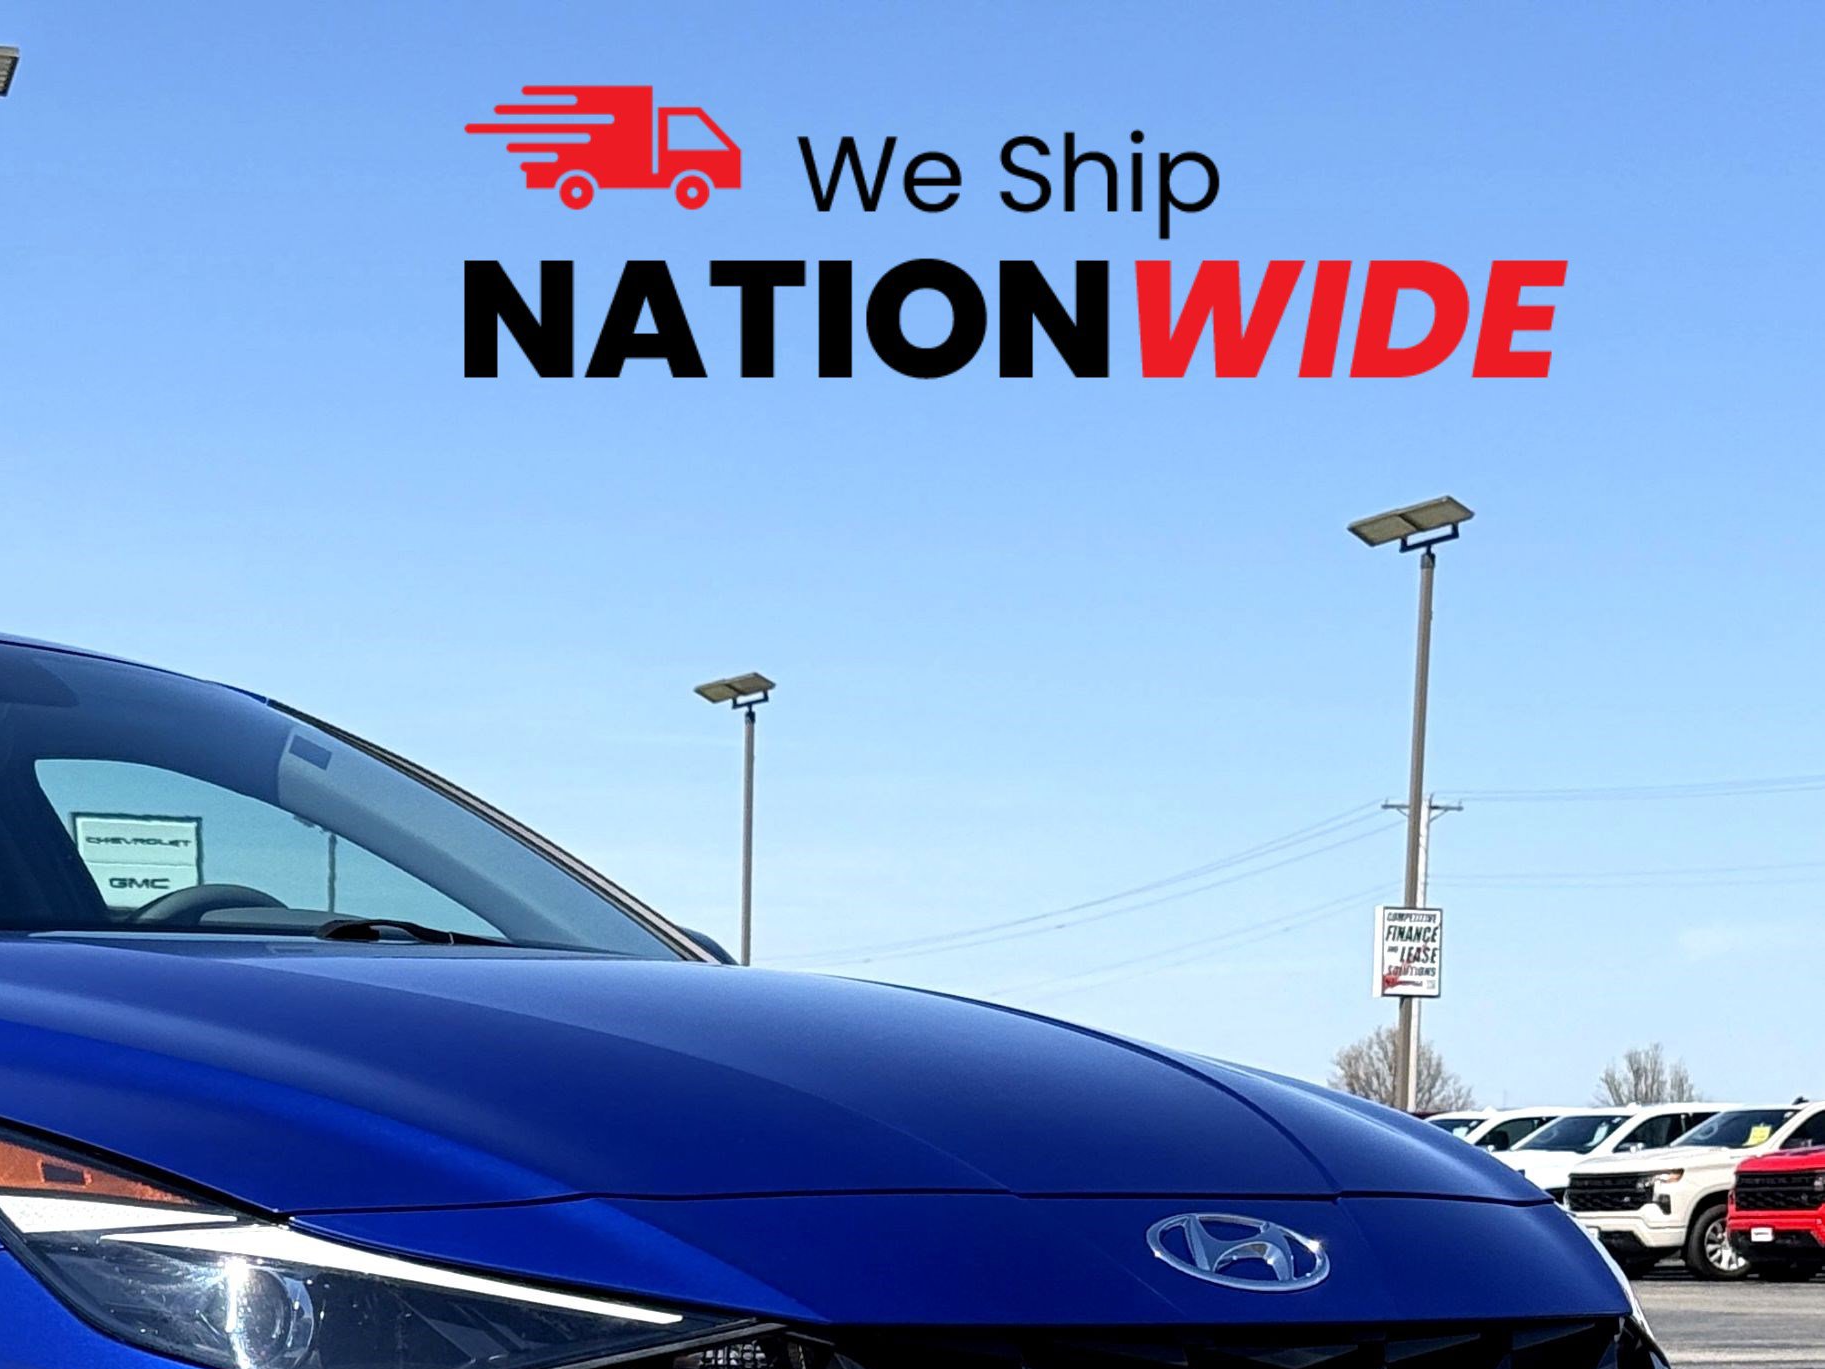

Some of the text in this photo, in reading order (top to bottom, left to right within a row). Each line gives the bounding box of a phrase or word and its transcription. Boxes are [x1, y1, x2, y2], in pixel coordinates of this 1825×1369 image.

[85, 836, 191, 847] CHEVROLET
[109, 877, 170, 889] GMC
[1385, 925, 1439, 943] FINANCE
[1399, 946, 1439, 963] LEASE
